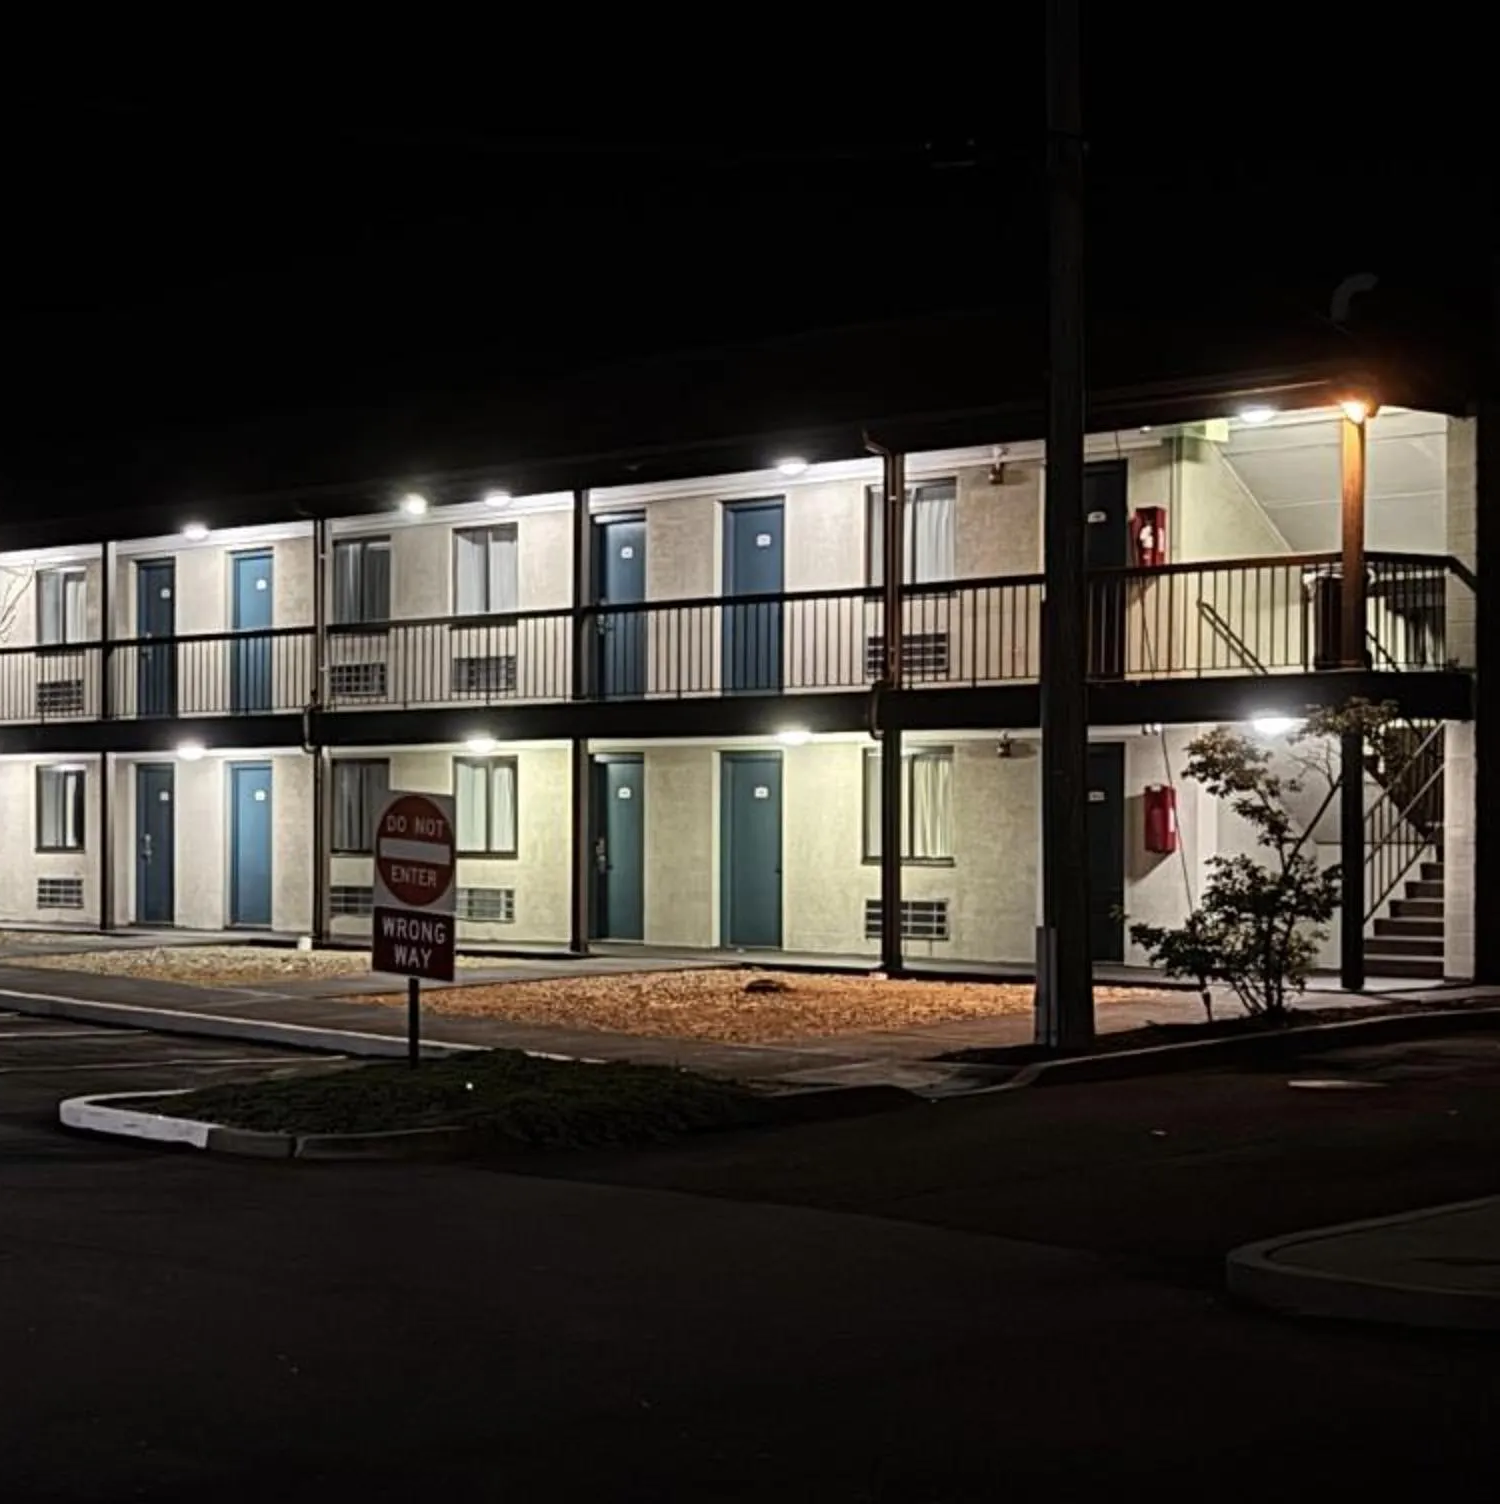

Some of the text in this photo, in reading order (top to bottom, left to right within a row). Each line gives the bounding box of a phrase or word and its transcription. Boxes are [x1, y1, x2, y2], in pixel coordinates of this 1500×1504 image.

[386, 816, 444, 838] DO NOT
[391, 864, 437, 888] ENTER
[381, 916, 446, 945] WRONG
[394, 944, 432, 969] WAY
